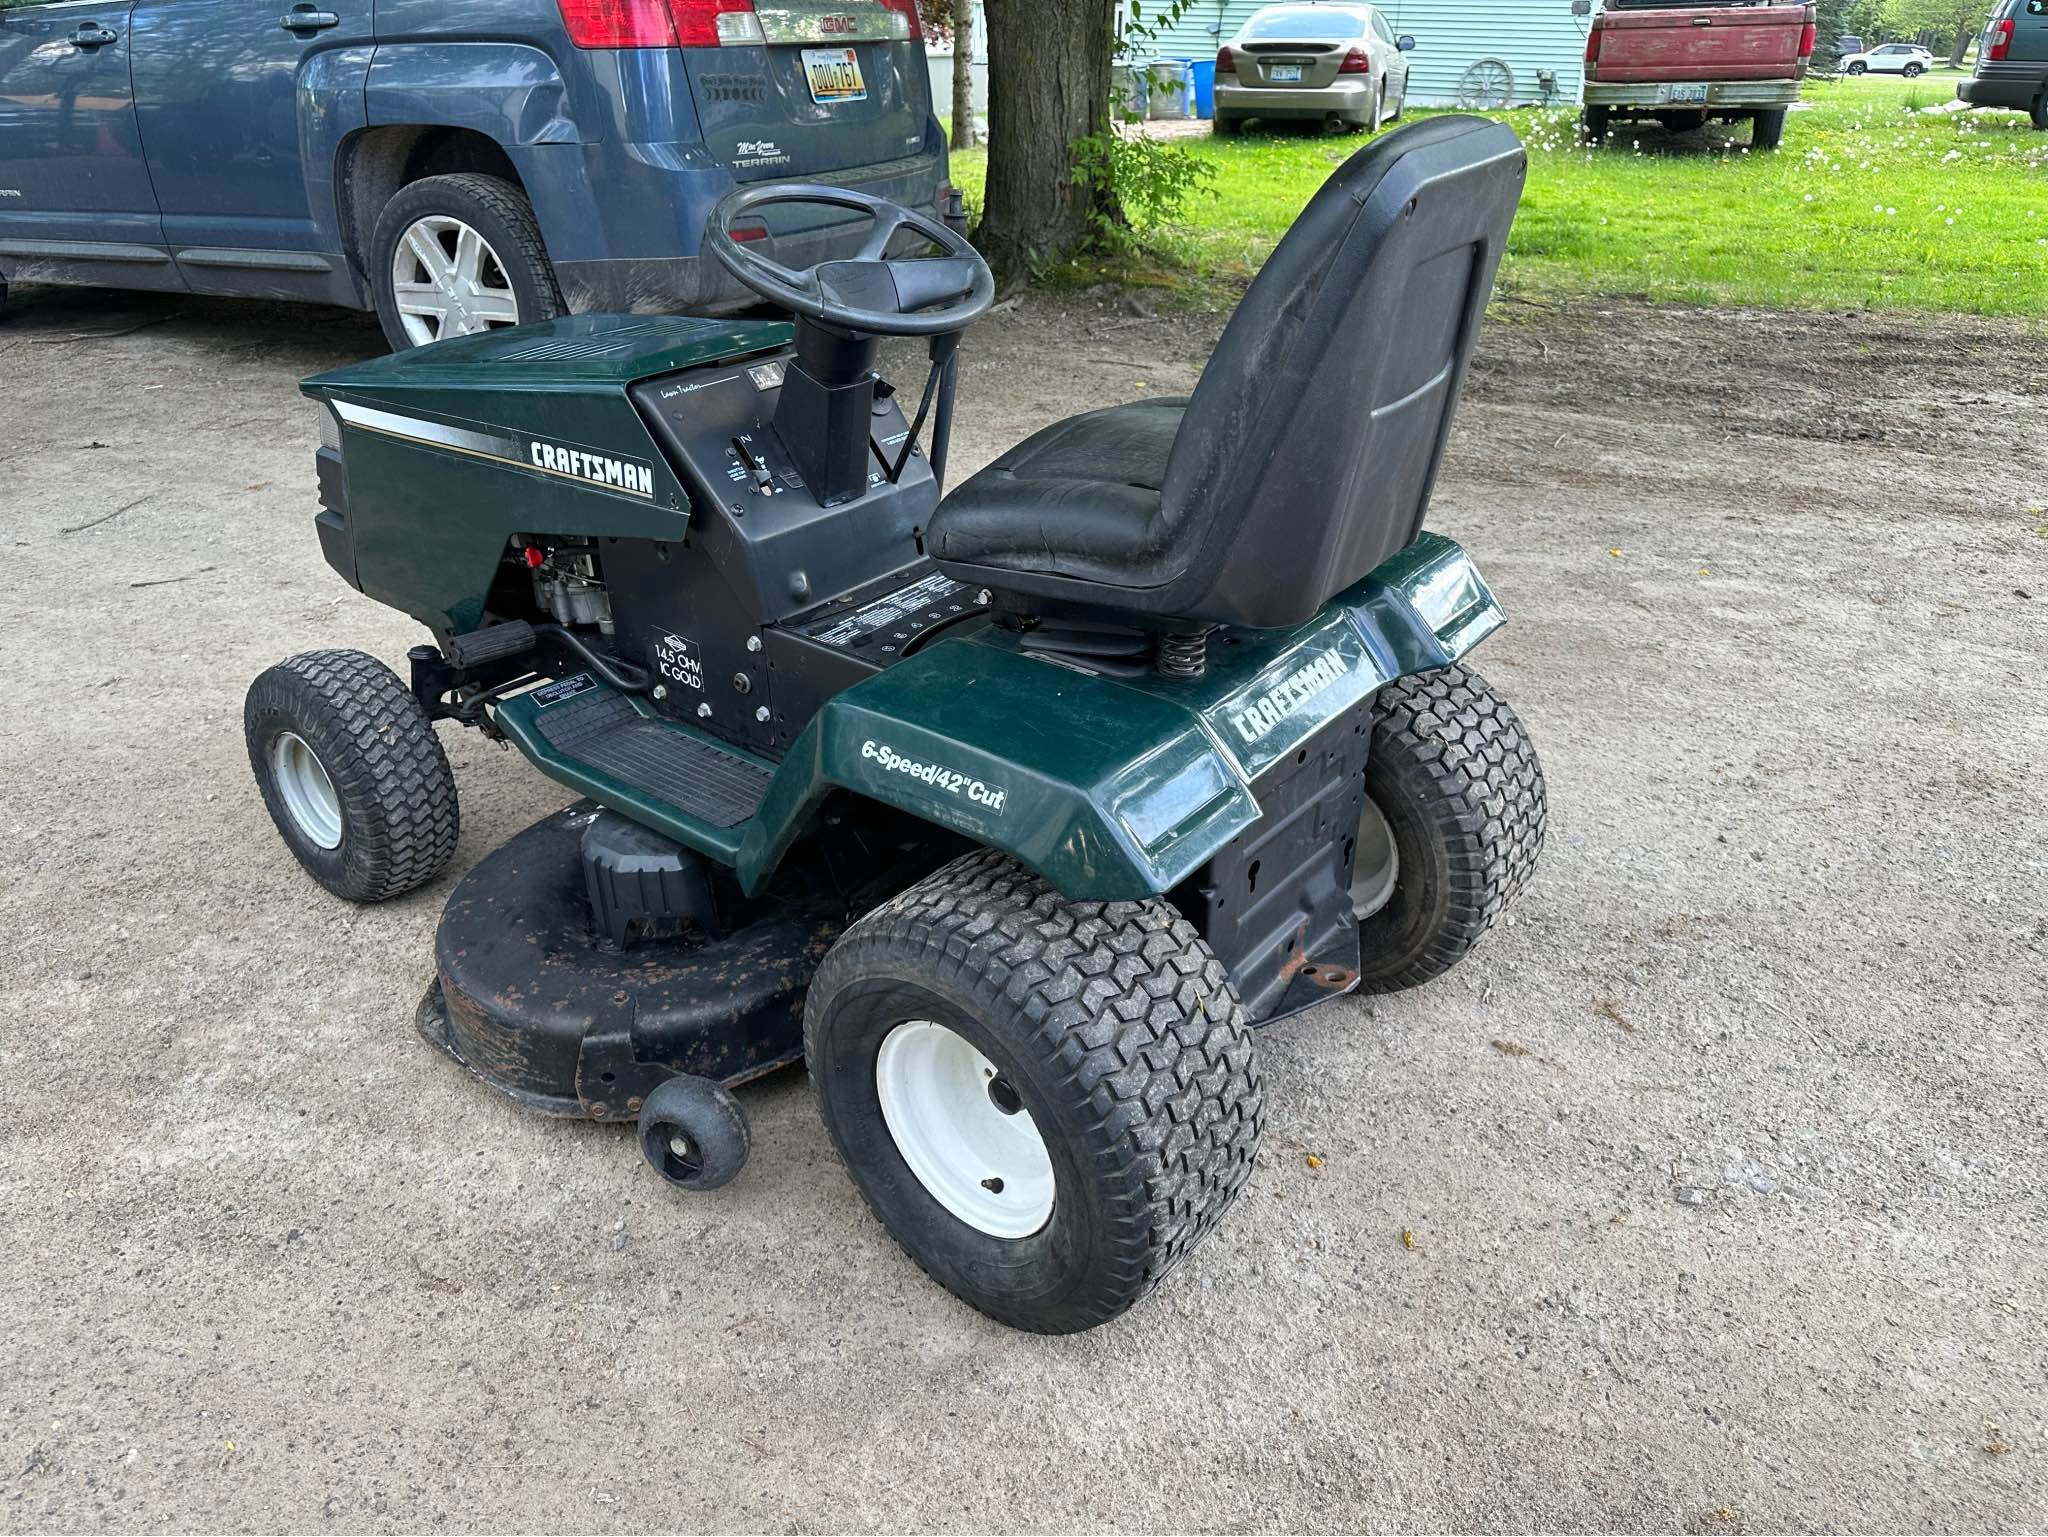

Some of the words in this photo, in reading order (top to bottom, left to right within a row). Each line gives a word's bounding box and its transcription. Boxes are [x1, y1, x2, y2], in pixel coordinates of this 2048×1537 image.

[821, 16, 858, 33] GMC
[836, 62, 857, 88] 767
[732, 155, 790, 168] TERRAIN
[530, 441, 653, 494] CRAFTSMAN
[660, 661, 671, 677] IC
[671, 666, 701, 689] GOLD
[678, 654, 700, 673] OHV
[1232, 646, 1349, 743] CRAFTSMAN
